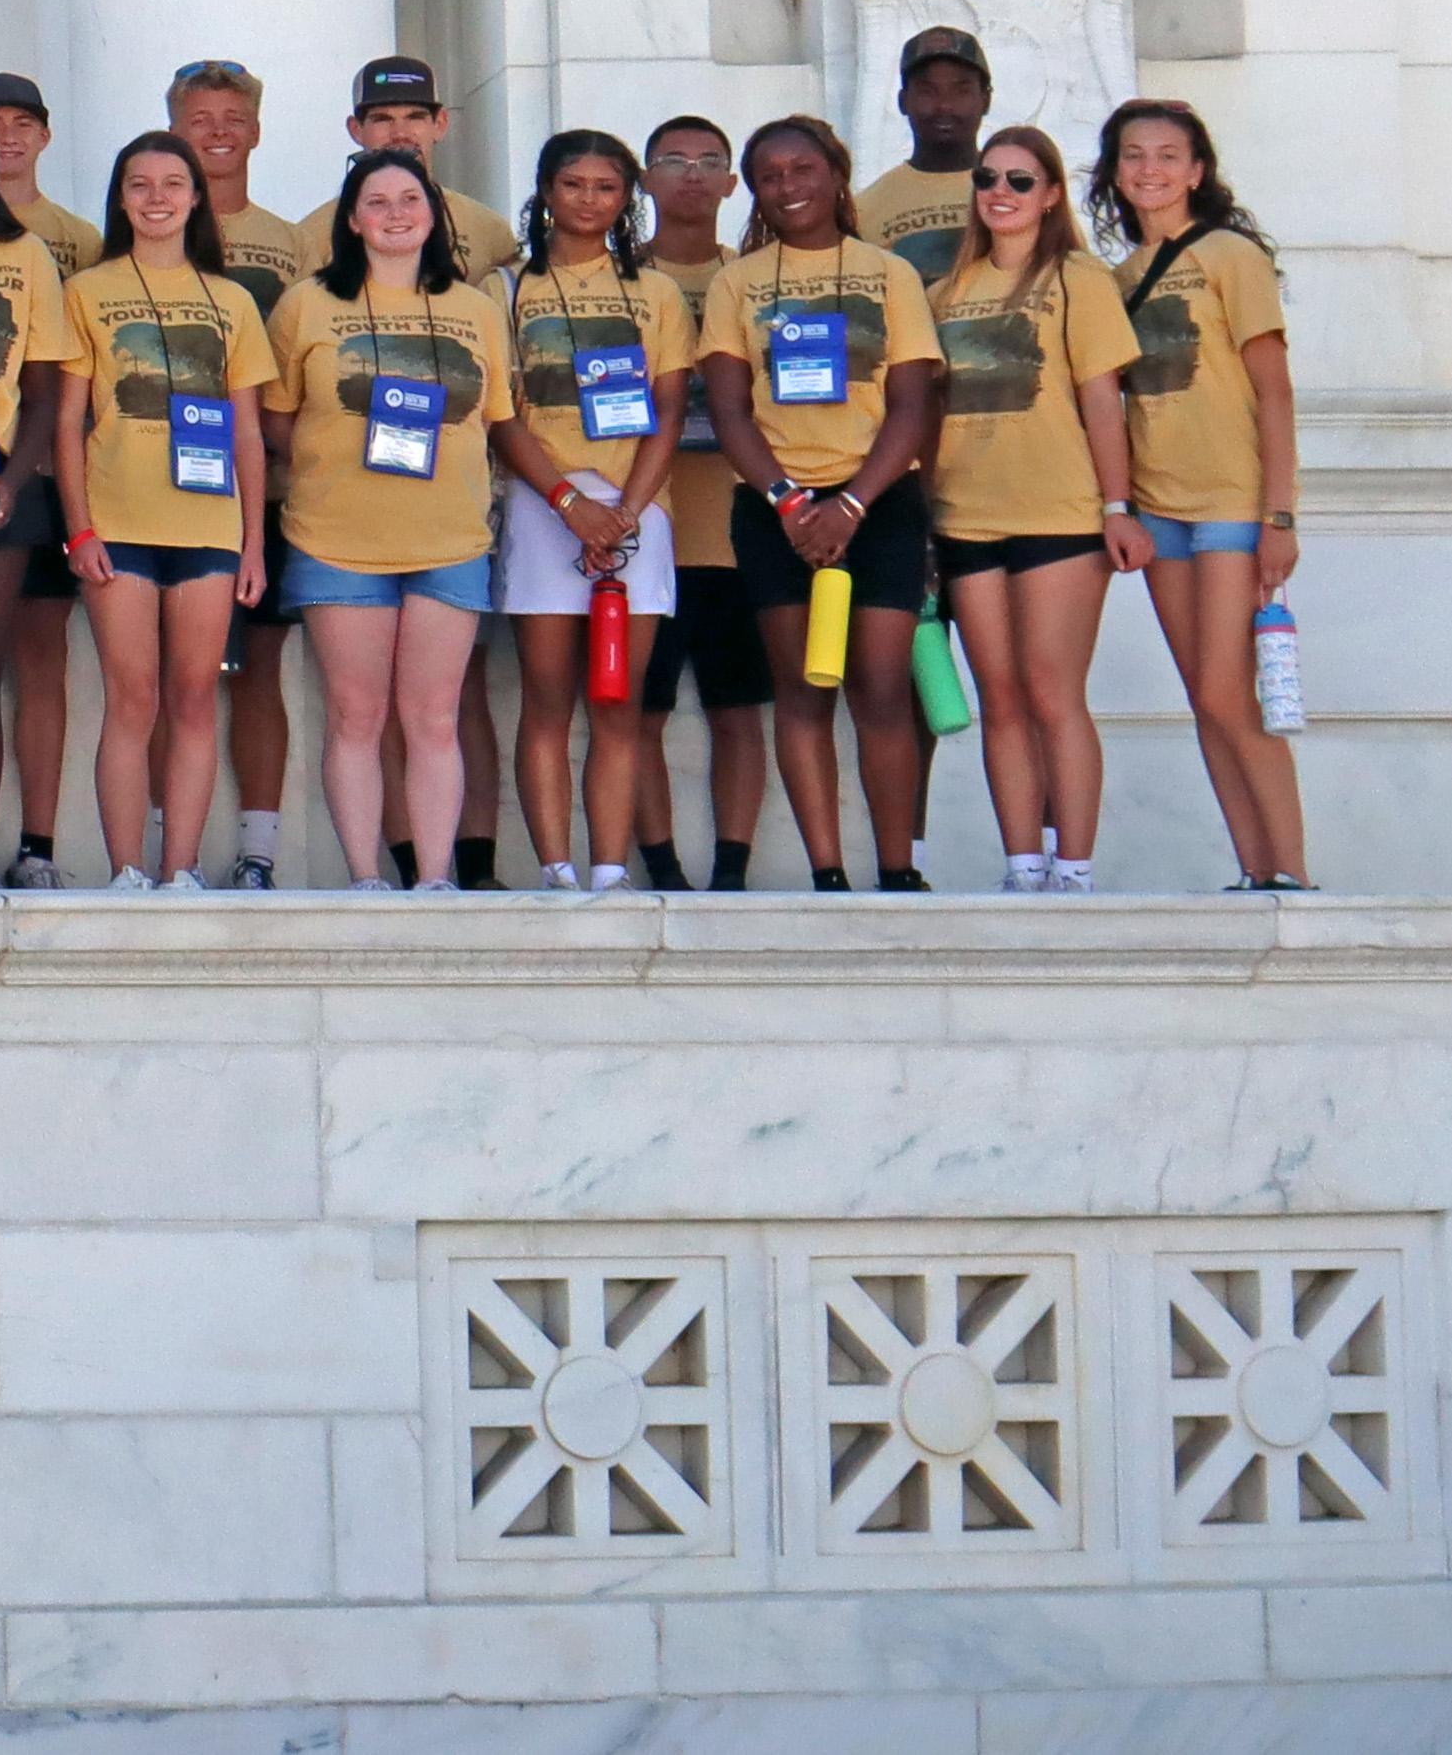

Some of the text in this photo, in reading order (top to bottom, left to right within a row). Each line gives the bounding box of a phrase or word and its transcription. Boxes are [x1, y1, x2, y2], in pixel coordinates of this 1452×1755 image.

[881, 212, 959, 239] YOUTH
[242, 251, 298, 277] TOUR
[745, 284, 824, 304] YOUTH
[98, 307, 233, 334] YOUTH TOUR
[524, 302, 651, 322] OUTH TOUR
[330, 322, 479, 342] YOUTH TOUR
